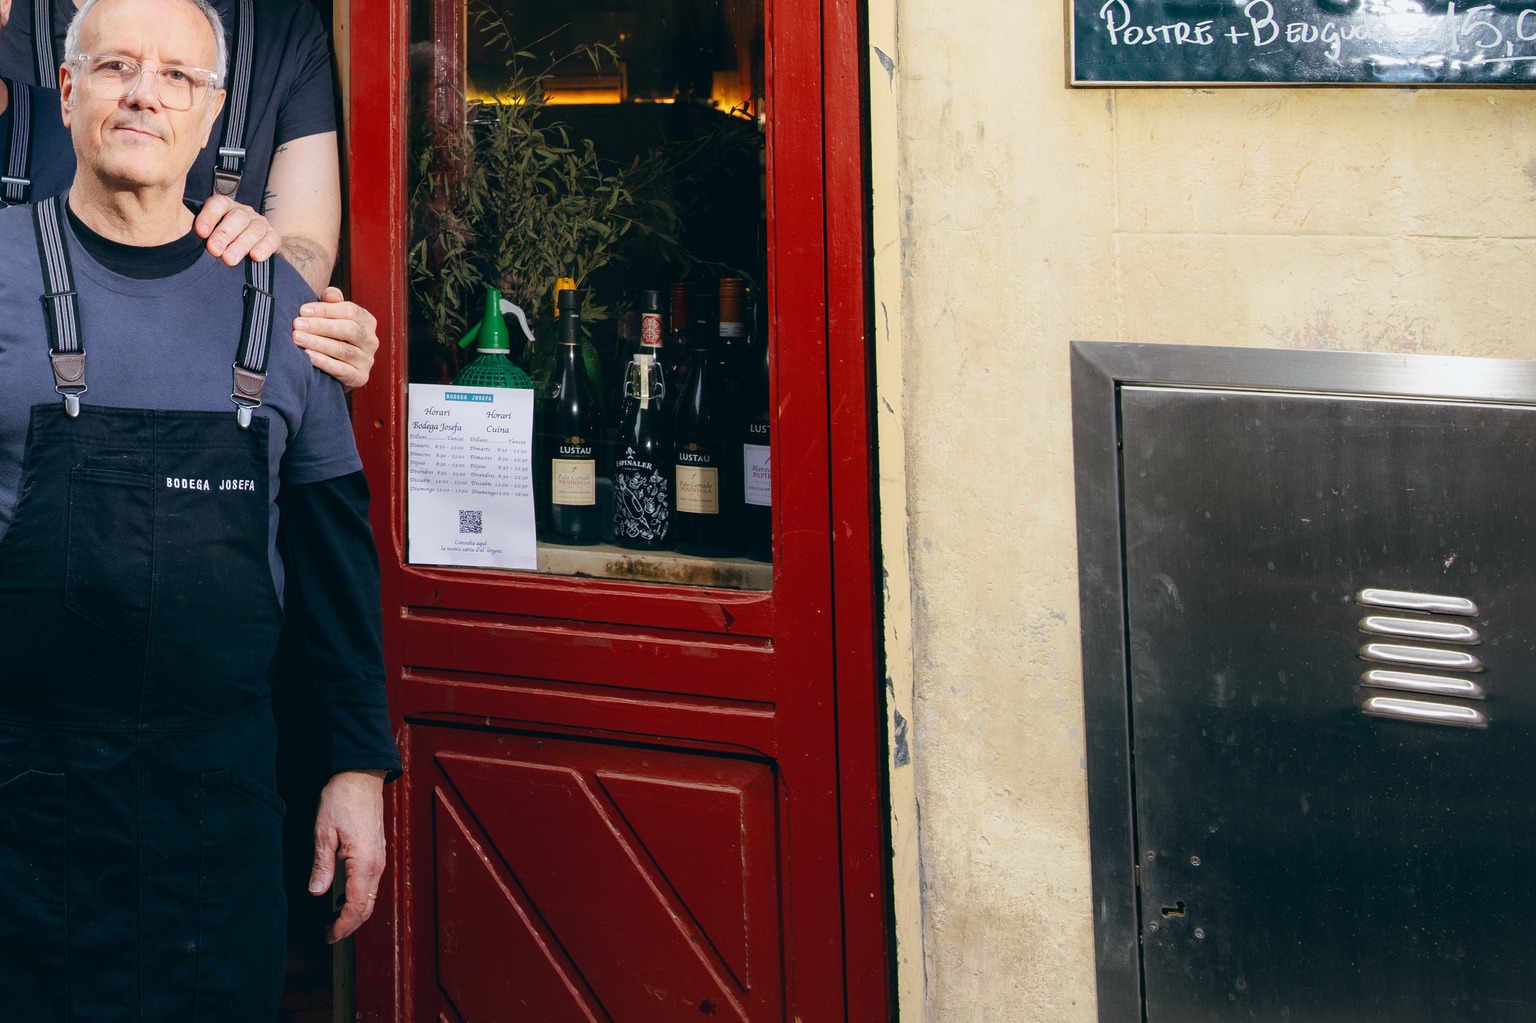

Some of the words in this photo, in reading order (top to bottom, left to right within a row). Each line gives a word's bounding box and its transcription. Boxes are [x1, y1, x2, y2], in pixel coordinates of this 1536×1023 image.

[412, 420, 438, 433] Bodega
[439, 421, 462, 434] Josefa
[560, 446, 591, 455] LUSTAU
[679, 453, 710, 462] LUSTAU
[166, 477, 210, 491] BODEGA
[219, 479, 255, 491] JOSEFA
